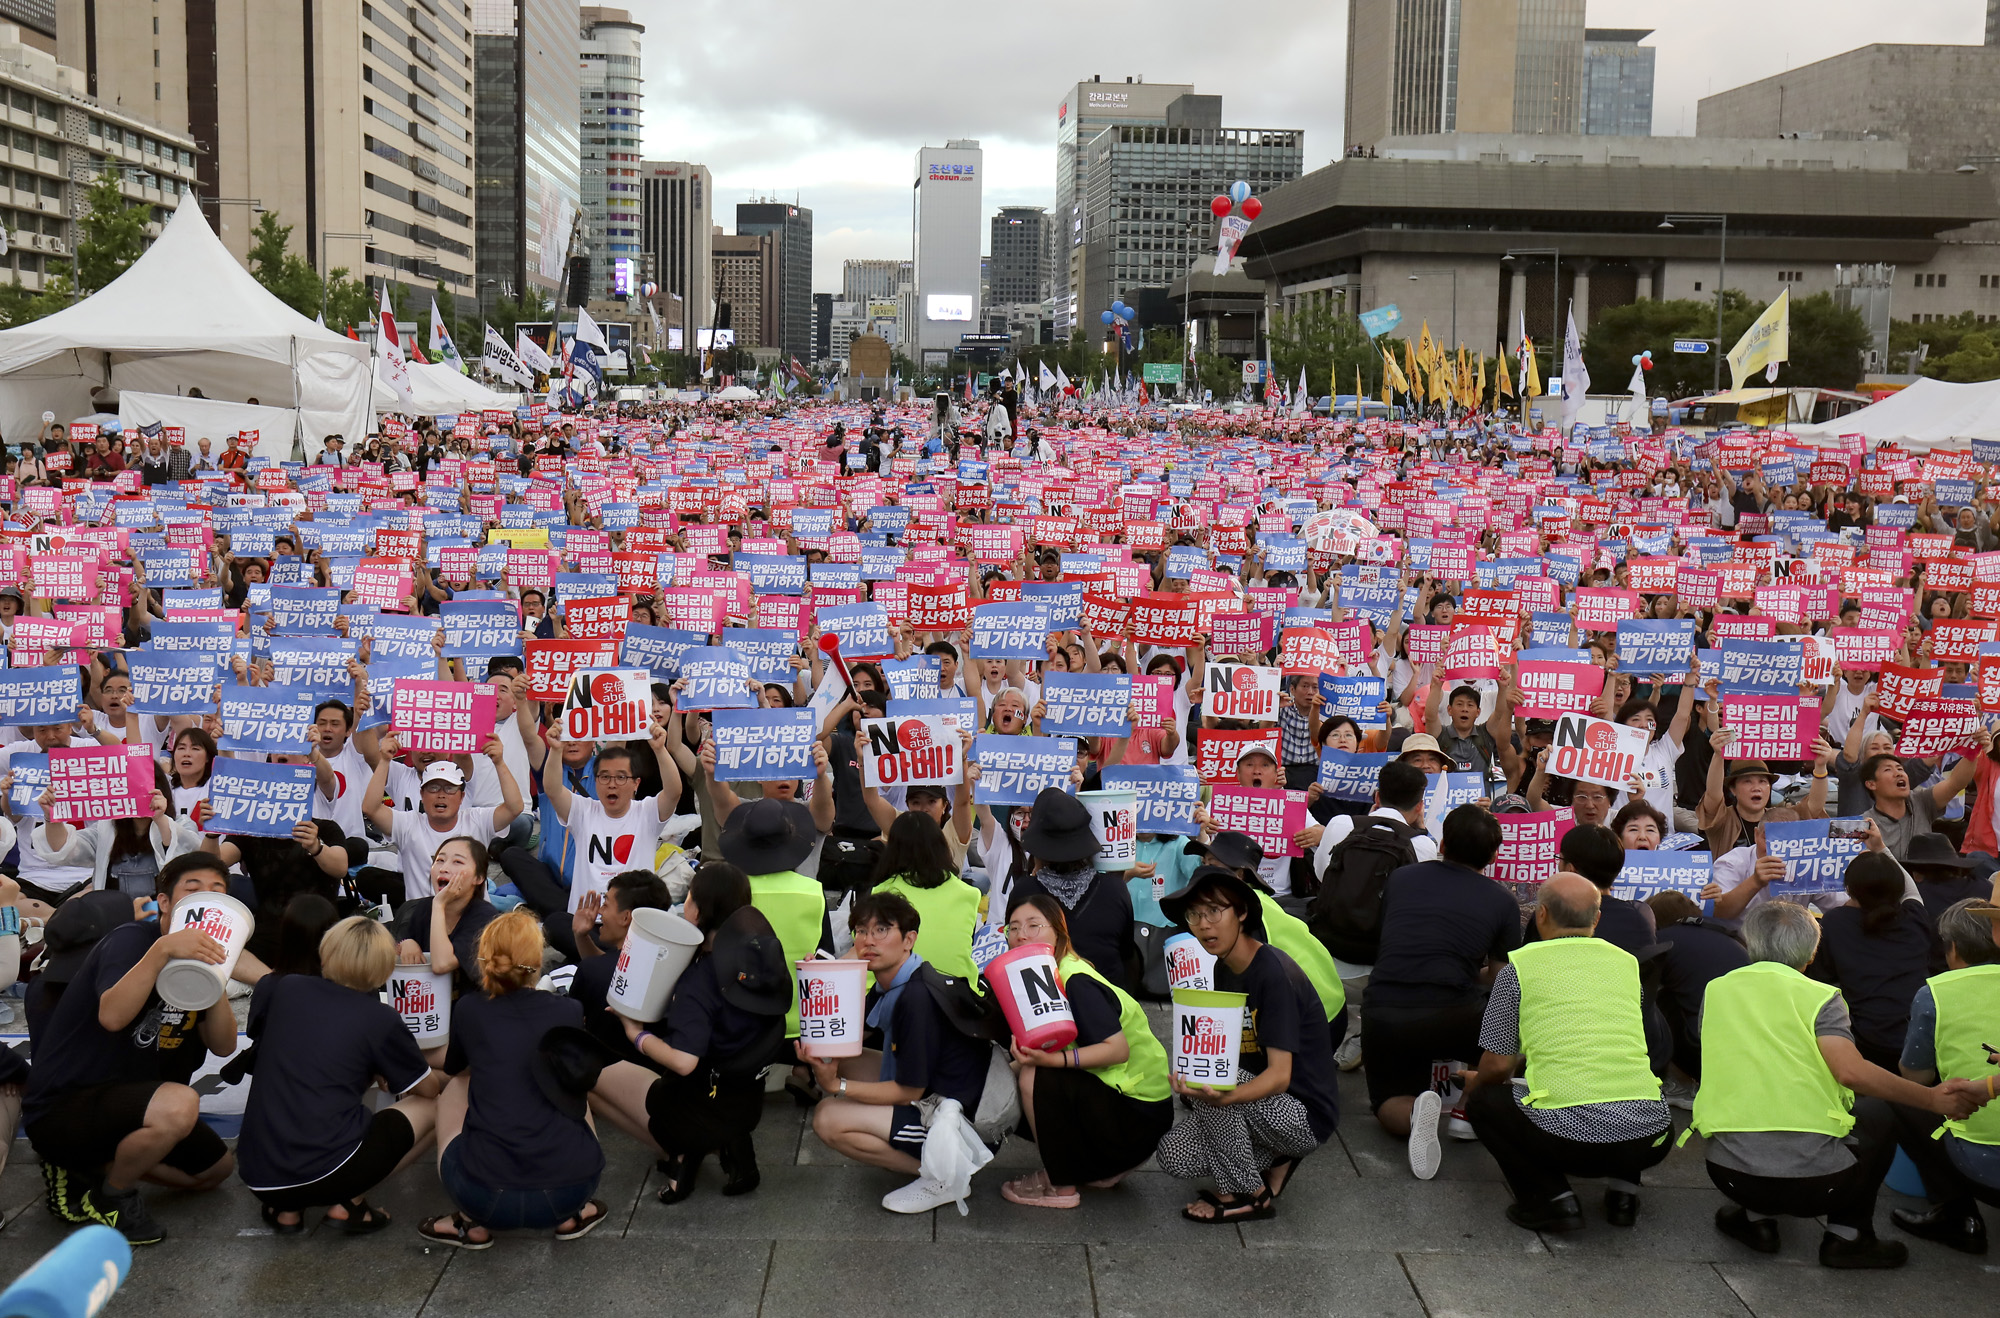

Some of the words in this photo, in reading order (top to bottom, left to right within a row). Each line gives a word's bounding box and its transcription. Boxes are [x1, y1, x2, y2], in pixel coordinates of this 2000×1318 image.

[929, 164, 974, 174] 조선일보
[33, 561, 83, 573] 한일군사
[1630, 564, 1677, 577] 친일적폐
[1630, 576, 1677, 589] 청산하자
[665, 593, 713, 607] 한일군사
[910, 591, 967, 610] 친일적폐
[1578, 595, 1630, 611] 강제징용
[443, 613, 518, 628] 한일군사협정
[567, 605, 629, 621] 친일적폐
[909, 608, 968, 625] 청산하자
[1134, 606, 1195, 624] 친일적폐
[568, 620, 627, 638] 청산하자
[974, 616, 1047, 631] 한일군사협정
[1134, 621, 1195, 640] 청산하자
[1213, 617, 1261, 631] 한일군사
[445, 630, 518, 648] 폐기하자
[972, 631, 1046, 650] 폐기하자
[1620, 632, 1692, 647] 한일군사협정
[1835, 634, 1891, 651] 강제징용
[1934, 625, 1997, 643] 친일적폐
[1286, 636, 1339, 657] 친일적폐
[531, 651, 613, 672] 친일적폐
[1284, 652, 1339, 673] 청산하자
[1620, 648, 1691, 665] 폐기하자
[1724, 652, 1800, 670] 한일군사협정
[131, 665, 214, 682] 한일군사협정
[681, 661, 748, 679] 한일군사협정
[887, 668, 940, 683] 한일군사협정
[1723, 665, 1799, 686] 폐기하자
[1521, 673, 1575, 690] 아베를
[134, 683, 213, 704] 폐기하자
[396, 689, 473, 710] 한일군사
[894, 683, 940, 700] 폐기하자
[1045, 687, 1130, 703] 한일군사협정
[1336, 696, 1361, 706] 제2의
[222, 700, 312, 720] 한일군사협정
[1213, 690, 1272, 716] 아베!
[1726, 703, 1798, 721] 한일군사
[395, 710, 471, 731] 정보협정
[569, 699, 647, 738] 아베!
[1045, 705, 1128, 726] 폐기하자
[222, 720, 309, 743] 폐기하자
[716, 724, 811, 745] 한일군사협정
[1725, 722, 1797, 740] 정보협정
[1905, 717, 1979, 738] 친일적폐
[718, 745, 811, 769] 폐기하자
[1724, 741, 1801, 760] 폐기하라!
[51, 755, 128, 777] 한일군사
[877, 745, 954, 783] 아베!
[979, 751, 1073, 772] 한일군사협정
[1555, 745, 1635, 782] 아베!
[53, 779, 129, 798] 정보협정
[212, 774, 312, 801] 한일군사협정
[53, 798, 138, 819] 폐기하라!
[212, 796, 308, 825] 폐기하자
[1214, 794, 1285, 815] 한일군사
[1214, 813, 1283, 834] 정보협정
[394, 994, 435, 1015] 아베!
[801, 995, 839, 1017] 아베!
[405, 1014, 441, 1034] 금함
[1182, 1035, 1226, 1055] 아베!
[1177, 1056, 1230, 1077] 모금함
